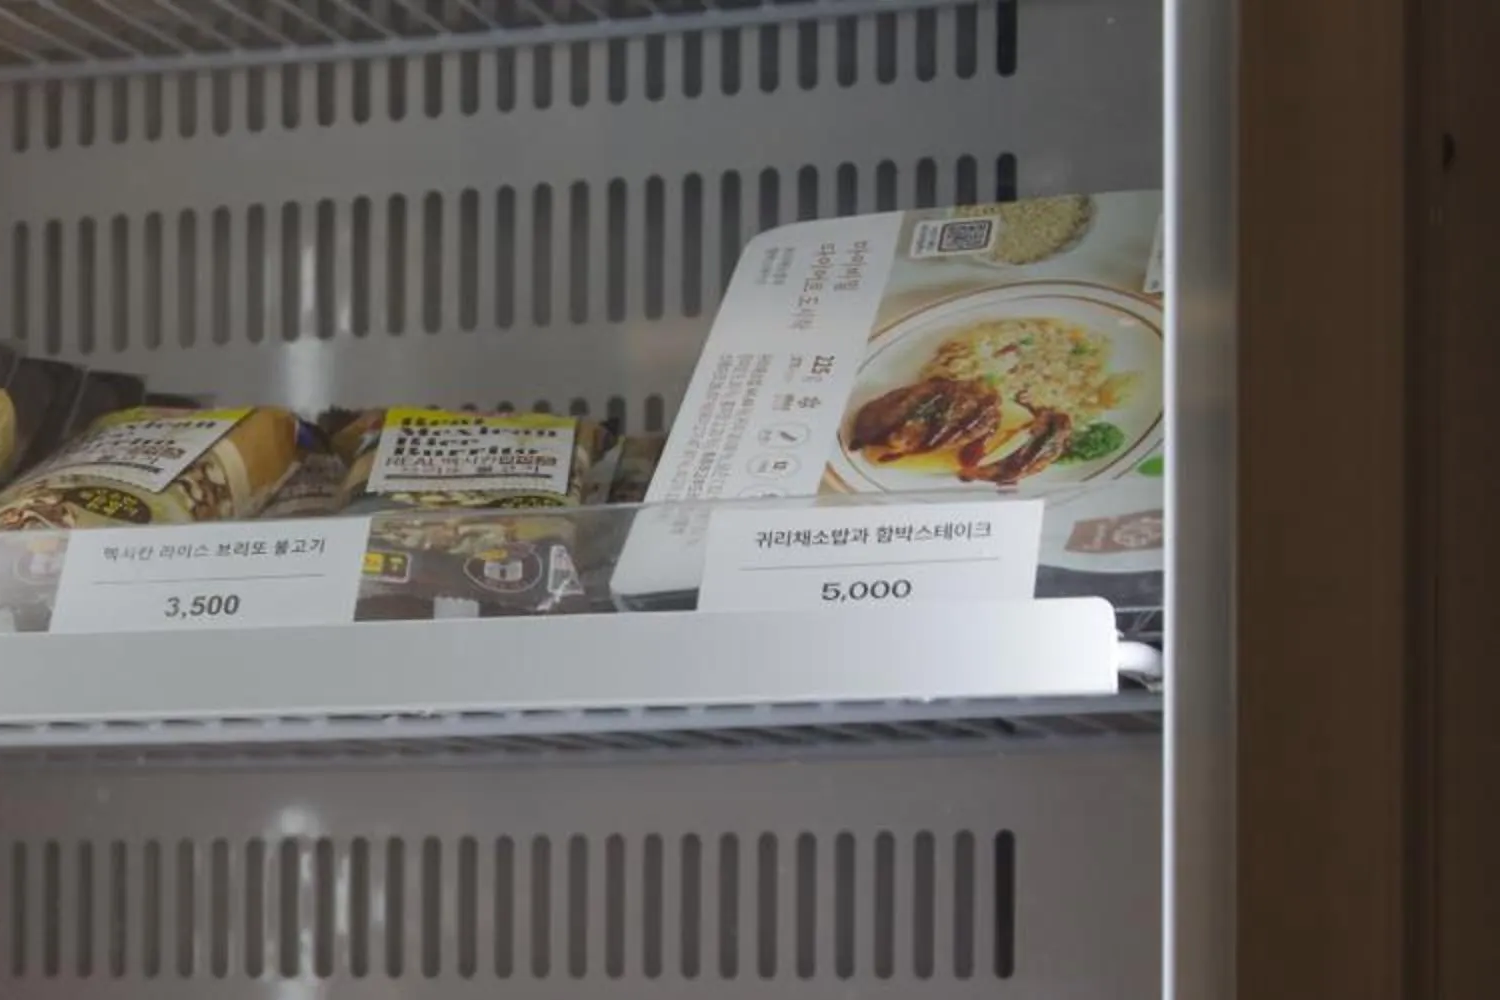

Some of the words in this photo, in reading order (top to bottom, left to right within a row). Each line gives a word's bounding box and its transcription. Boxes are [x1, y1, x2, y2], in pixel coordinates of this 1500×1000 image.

[755, 528, 869, 548] 귀리채소밥과
[876, 521, 992, 544] 함박스테이크
[159, 543, 211, 559] 라이스
[216, 541, 269, 557] 브리또
[273, 537, 326, 556] 불고기
[821, 579, 912, 602] 5,000
[164, 595, 241, 619] 3,500
